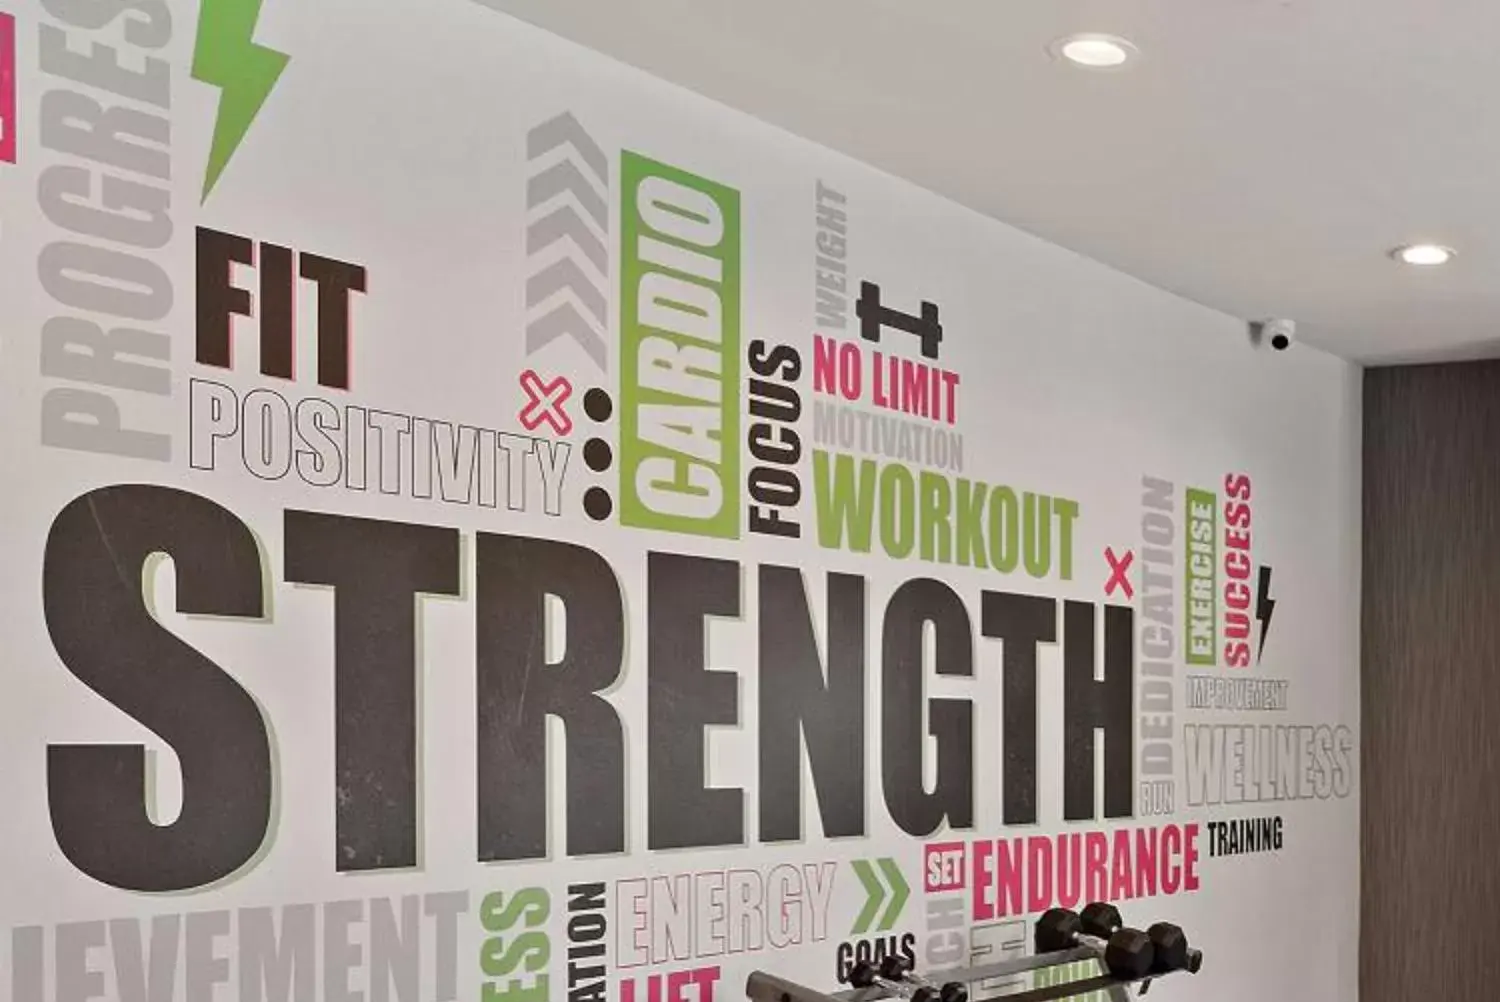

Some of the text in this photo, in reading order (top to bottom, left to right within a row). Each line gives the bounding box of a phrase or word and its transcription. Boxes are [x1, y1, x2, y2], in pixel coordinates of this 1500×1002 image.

[195, 225, 366, 391] FIT
[815, 180, 848, 331] WEIGHT
[635, 175, 725, 520] CARDIO
[813, 334, 960, 424] NO LIMIT
[189, 377, 572, 517] POSITIVITY
[747, 339, 802, 539] FOCUS
[813, 400, 963, 473] MOTIVATION
[812, 448, 1079, 581] WORKOUT
[1189, 498, 1214, 656] EXERCISE
[1224, 473, 1251, 667] SUCCESS
[43, 483, 1135, 895] STRENGTH
[1140, 475, 1175, 777] DEDICATION
[1140, 779, 1175, 817] RUN
[1184, 723, 1352, 806] WELLNESS
[926, 848, 965, 888] SET
[973, 824, 1199, 921] ENDURANCE
[1208, 816, 1283, 857] TRAINING
[615, 860, 837, 969] ENERGY
